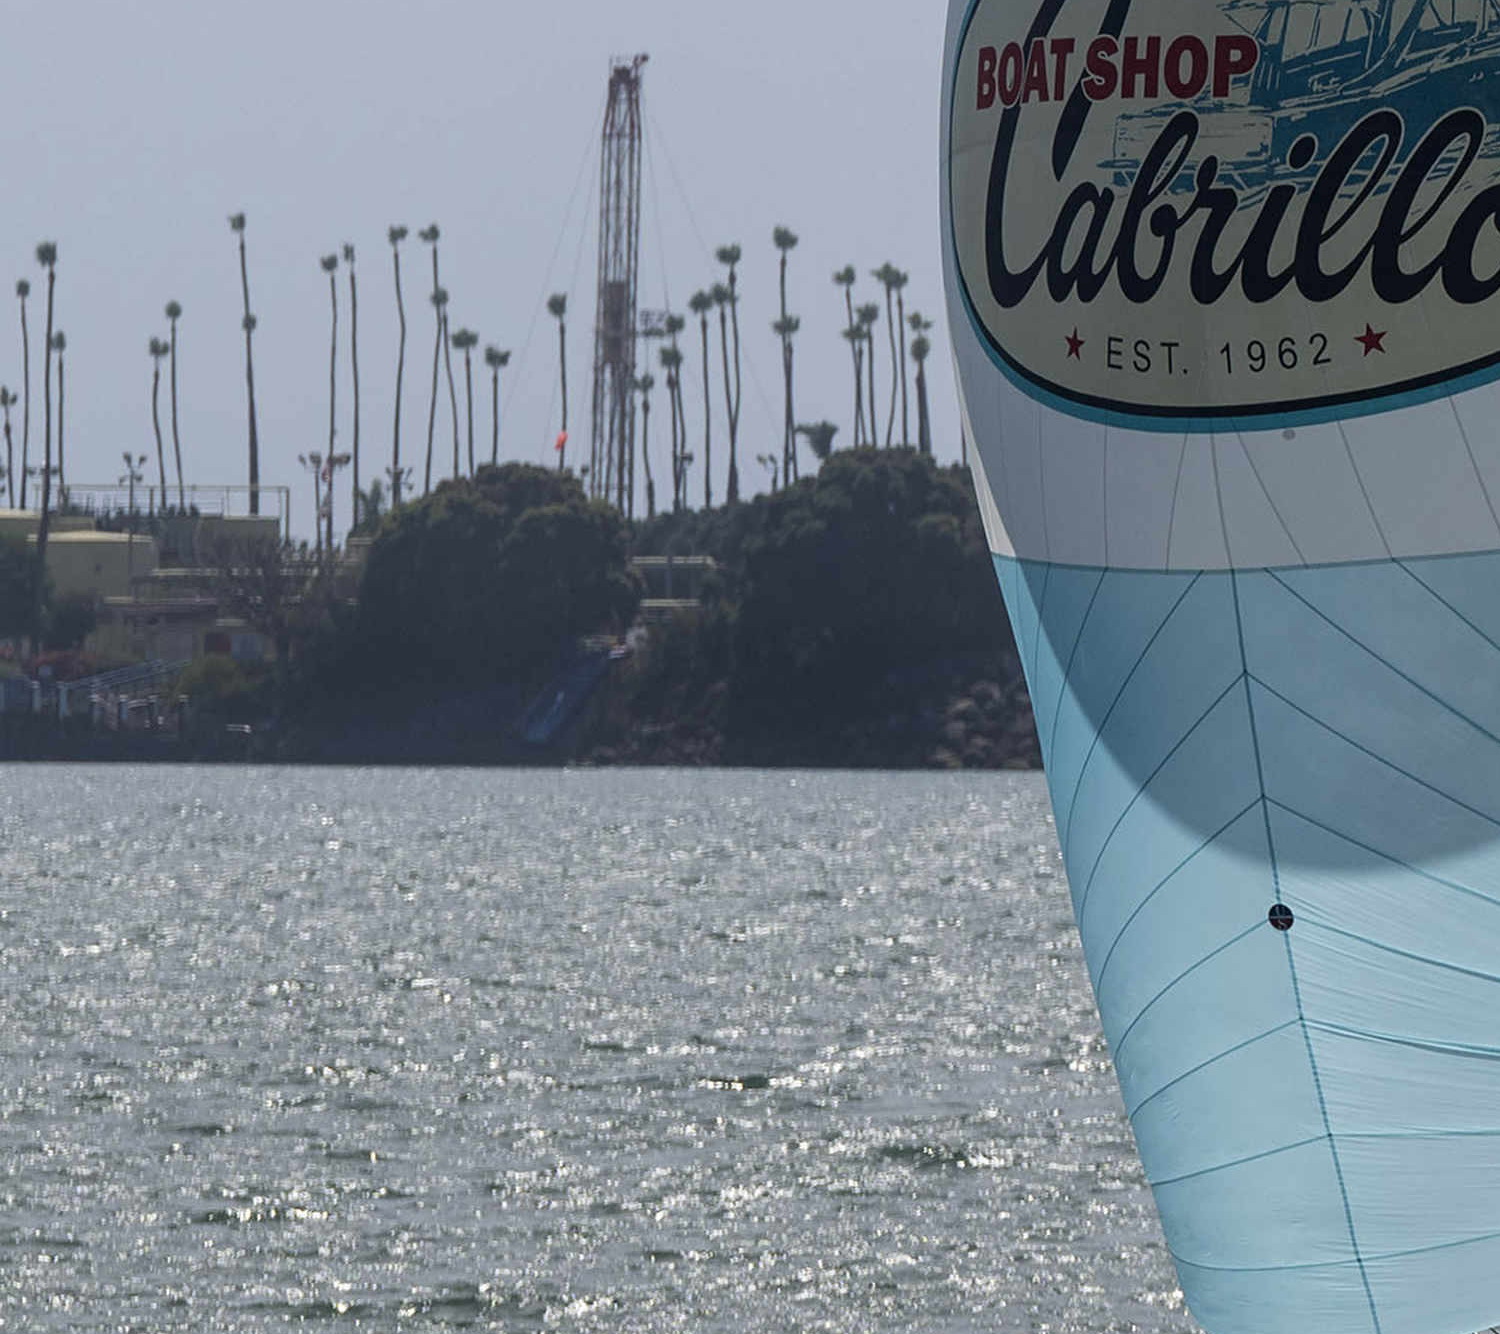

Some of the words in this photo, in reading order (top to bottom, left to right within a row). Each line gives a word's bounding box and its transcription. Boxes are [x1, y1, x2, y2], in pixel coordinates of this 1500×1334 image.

[975, 38, 1075, 110] BOAT
[1082, 34, 1260, 102] SHOP
[1106, 336, 1189, 375] EST.
[1219, 332, 1332, 375] 1962
